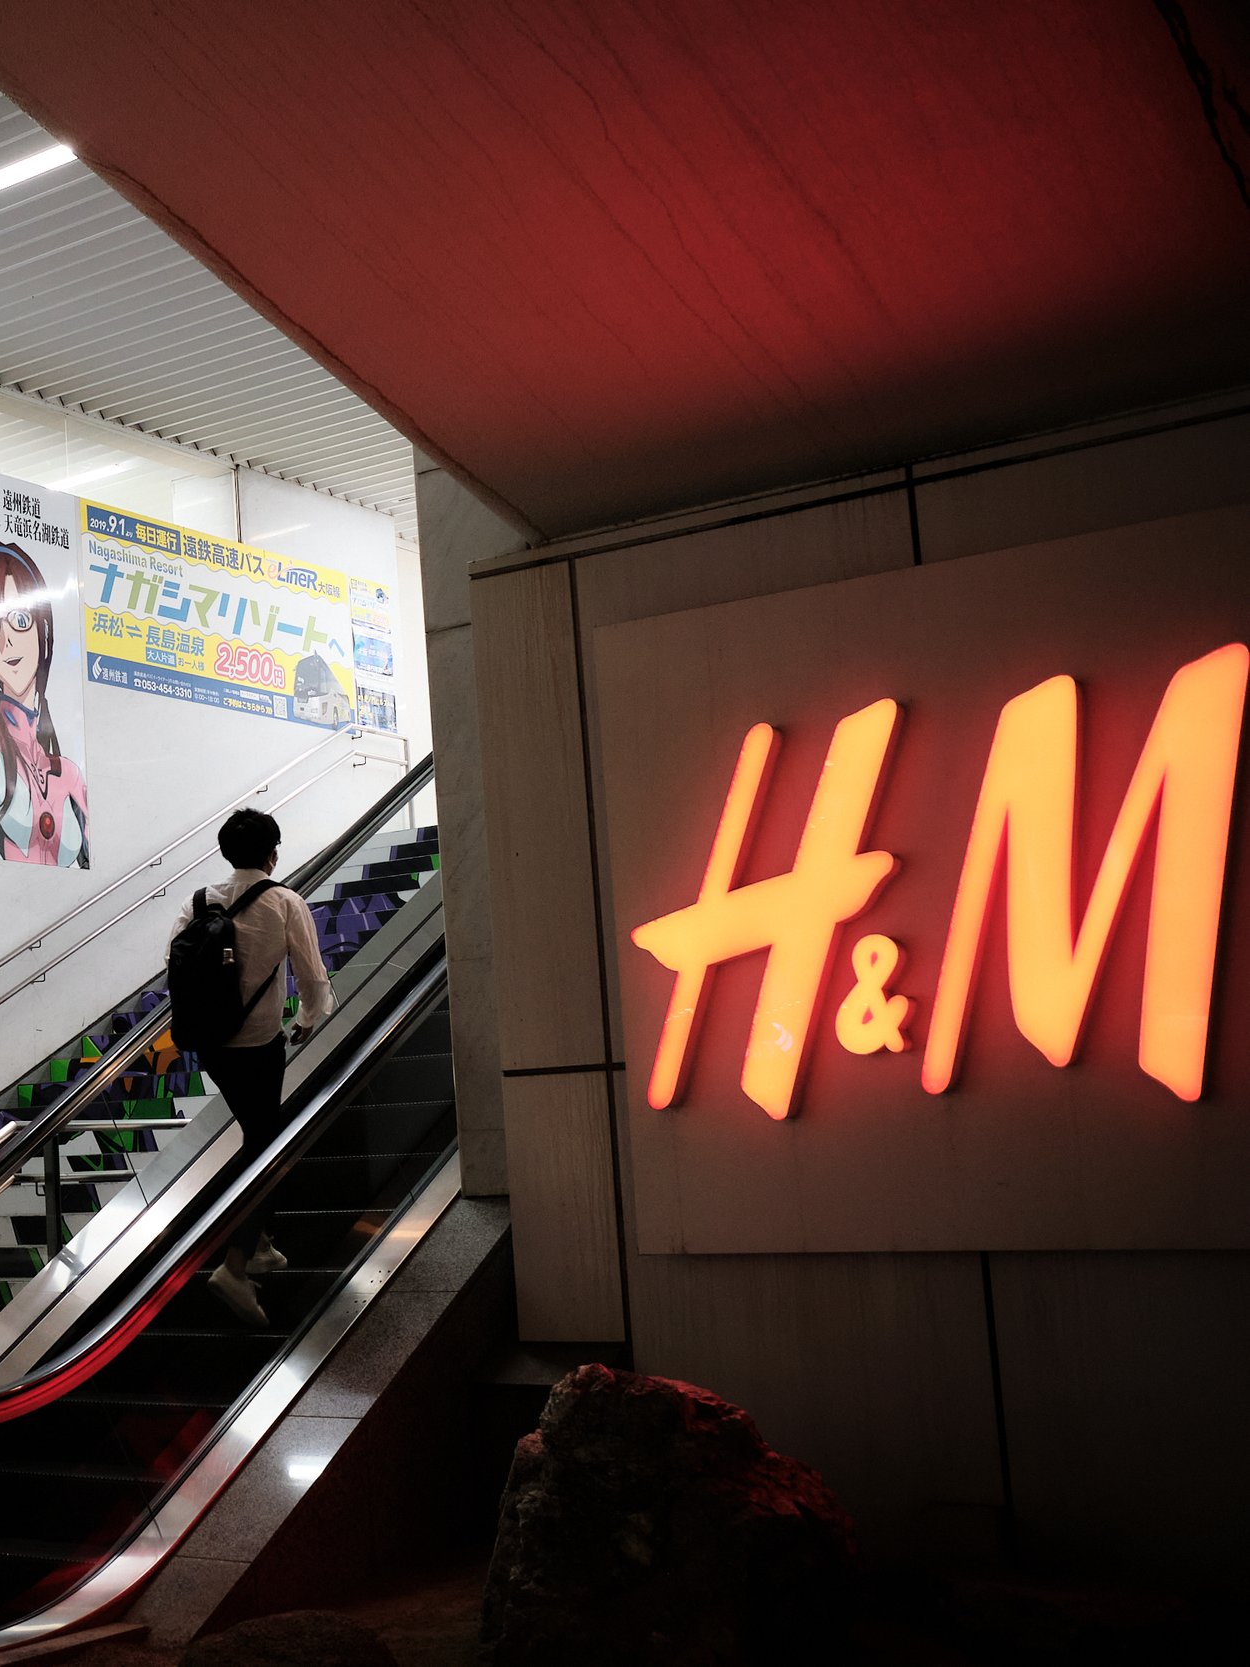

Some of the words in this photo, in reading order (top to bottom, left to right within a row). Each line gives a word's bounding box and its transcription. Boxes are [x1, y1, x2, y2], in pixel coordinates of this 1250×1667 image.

[2, 488, 42, 519] 遠州鉄道
[3, 512, 71, 551] 天竜浜名湖鉄道
[135, 522, 178, 552] 毎日運行
[182, 533, 266, 578] 遠鉄高速バス
[88, 539, 148, 569] Nagashima
[149, 556, 184, 578] Resort
[88, 561, 345, 658] ナガシマリゾートへ
[91, 611, 125, 638] 浜松
[145, 625, 206, 657] 長島温泉
[102, 667, 128, 685] 遠州鉄道
[215, 643, 286, 689] 2,500円
[631, 642, 1250, 1121] H&M
